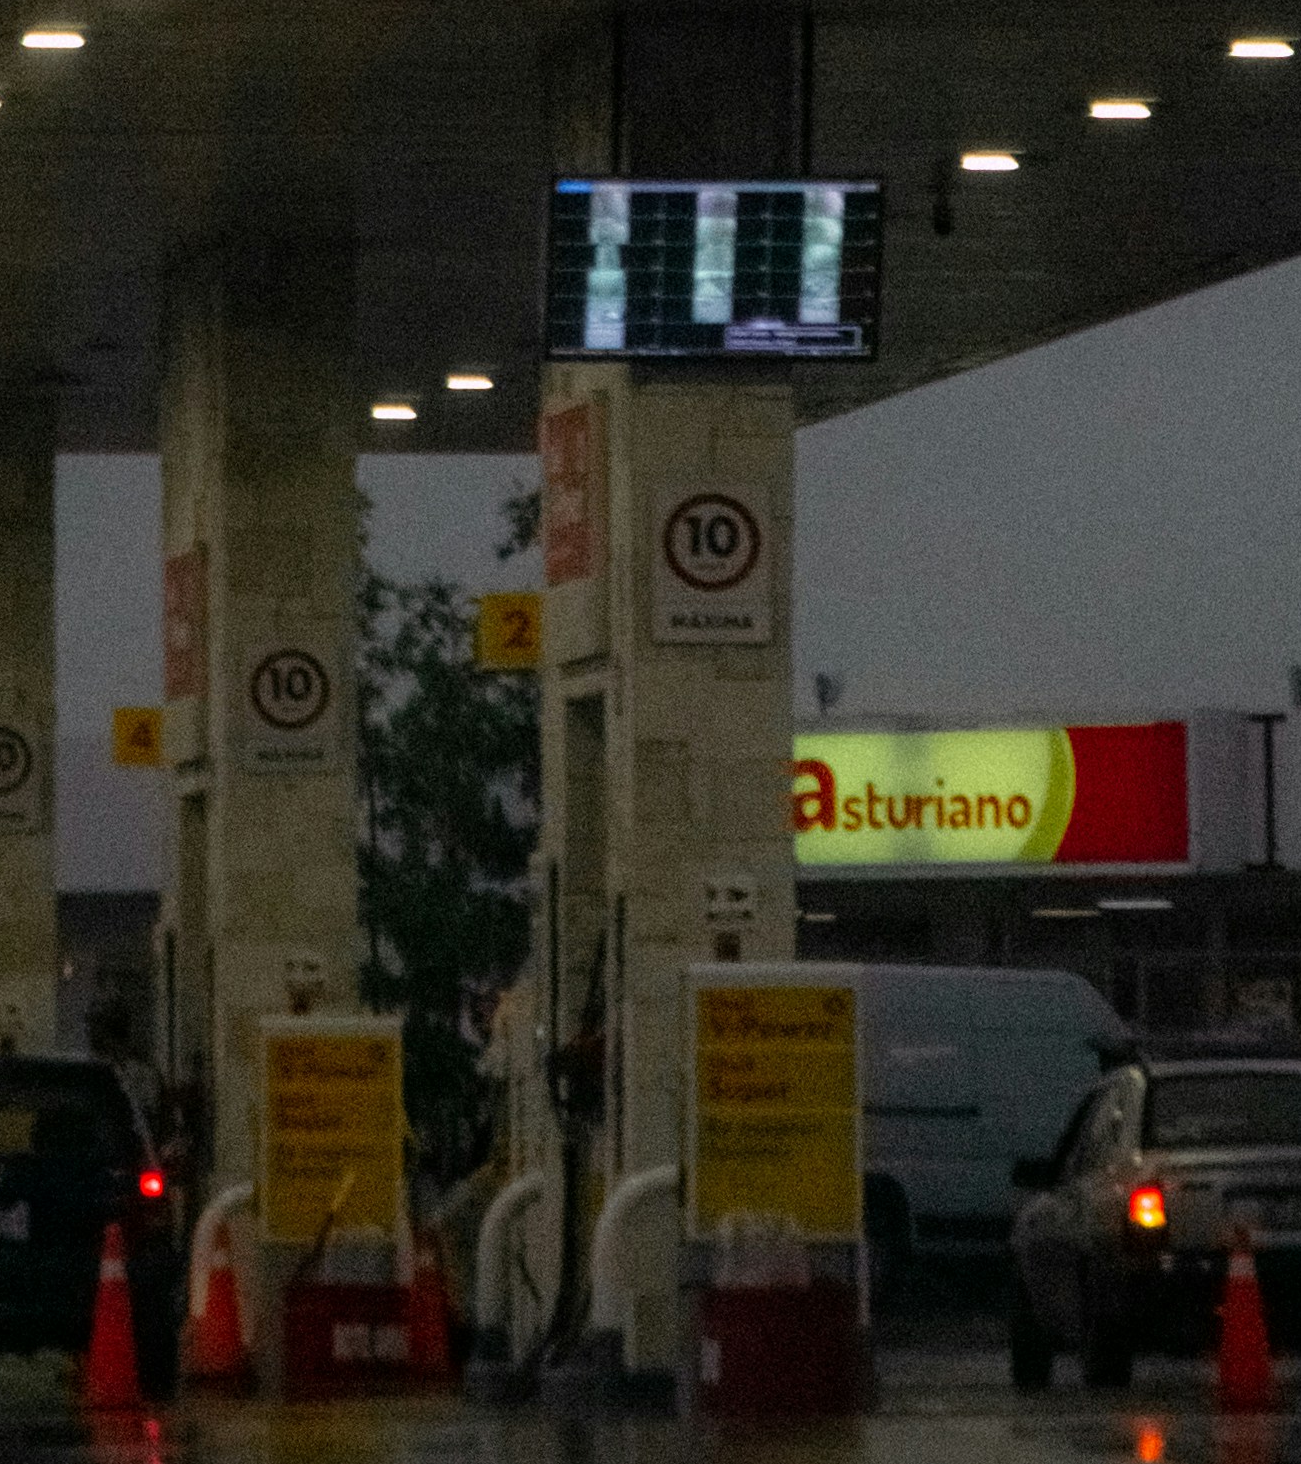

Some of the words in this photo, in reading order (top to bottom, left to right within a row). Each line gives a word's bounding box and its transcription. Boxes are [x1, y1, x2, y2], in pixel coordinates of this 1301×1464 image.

[685, 515, 739, 558] 10
[503, 610, 532, 648] 2
[270, 665, 313, 702] 10
[790, 759, 1032, 833] asturiano
